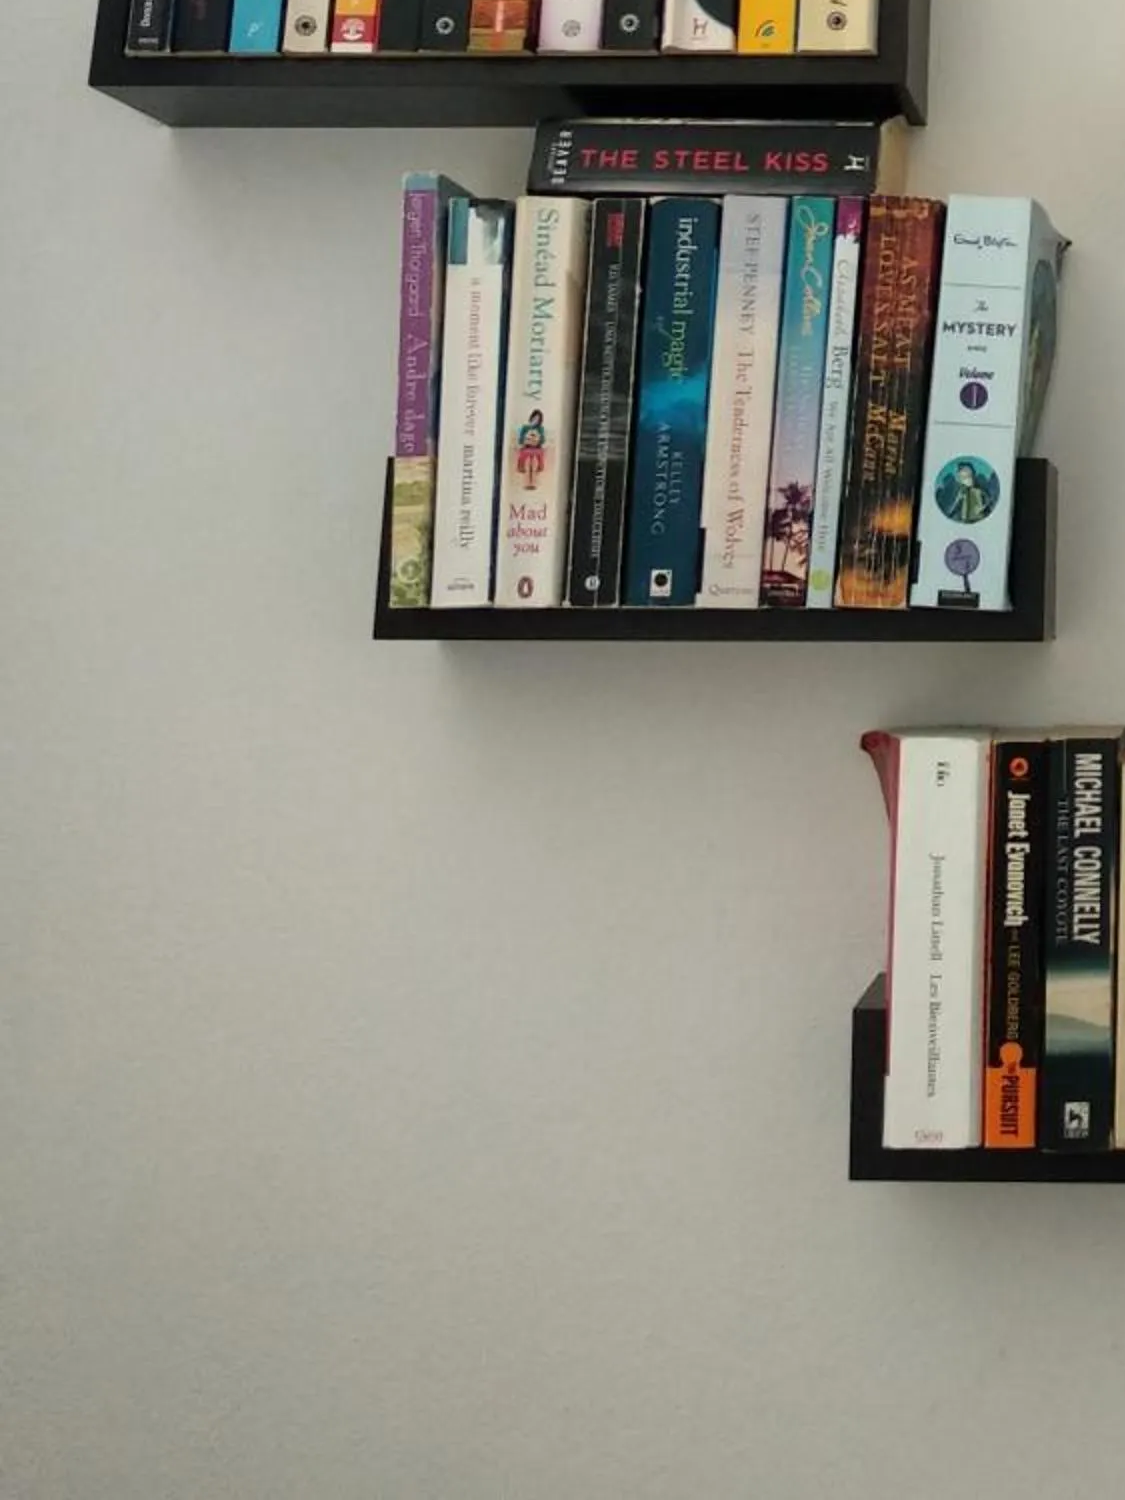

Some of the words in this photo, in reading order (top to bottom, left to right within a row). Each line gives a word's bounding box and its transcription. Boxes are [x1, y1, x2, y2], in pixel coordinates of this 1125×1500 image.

[580, 149, 639, 171] THE
[654, 150, 749, 172] STEEL
[763, 152, 830, 173] KISS
[533, 208, 559, 288] Sinéad
[671, 217, 698, 315] industrial
[469, 290, 483, 349] moment
[523, 296, 555, 402] Moriarty
[943, 321, 1017, 337] MYSTERY
[466, 353, 482, 381] like
[664, 319, 690, 383] magic
[735, 347, 755, 382] The
[824, 344, 850, 389] Berg
[463, 384, 480, 436] forever
[728, 388, 752, 479] Tenderness
[460, 444, 475, 506] martina
[650, 421, 673, 535] ARMSTRONG
[669, 450, 685, 505] KELLEY
[727, 481, 747, 500] of
[507, 502, 548, 519] Mad
[722, 508, 746, 570] Wolves
[1006, 790, 1031, 839] Janet
[1073, 753, 1103, 838] MICHAEL
[928, 852, 947, 917] Jonathan
[1003, 841, 1033, 927] Evanovich
[1072, 845, 1102, 945] CONNELLY
[999, 1073, 1021, 1138] PURSUIT
